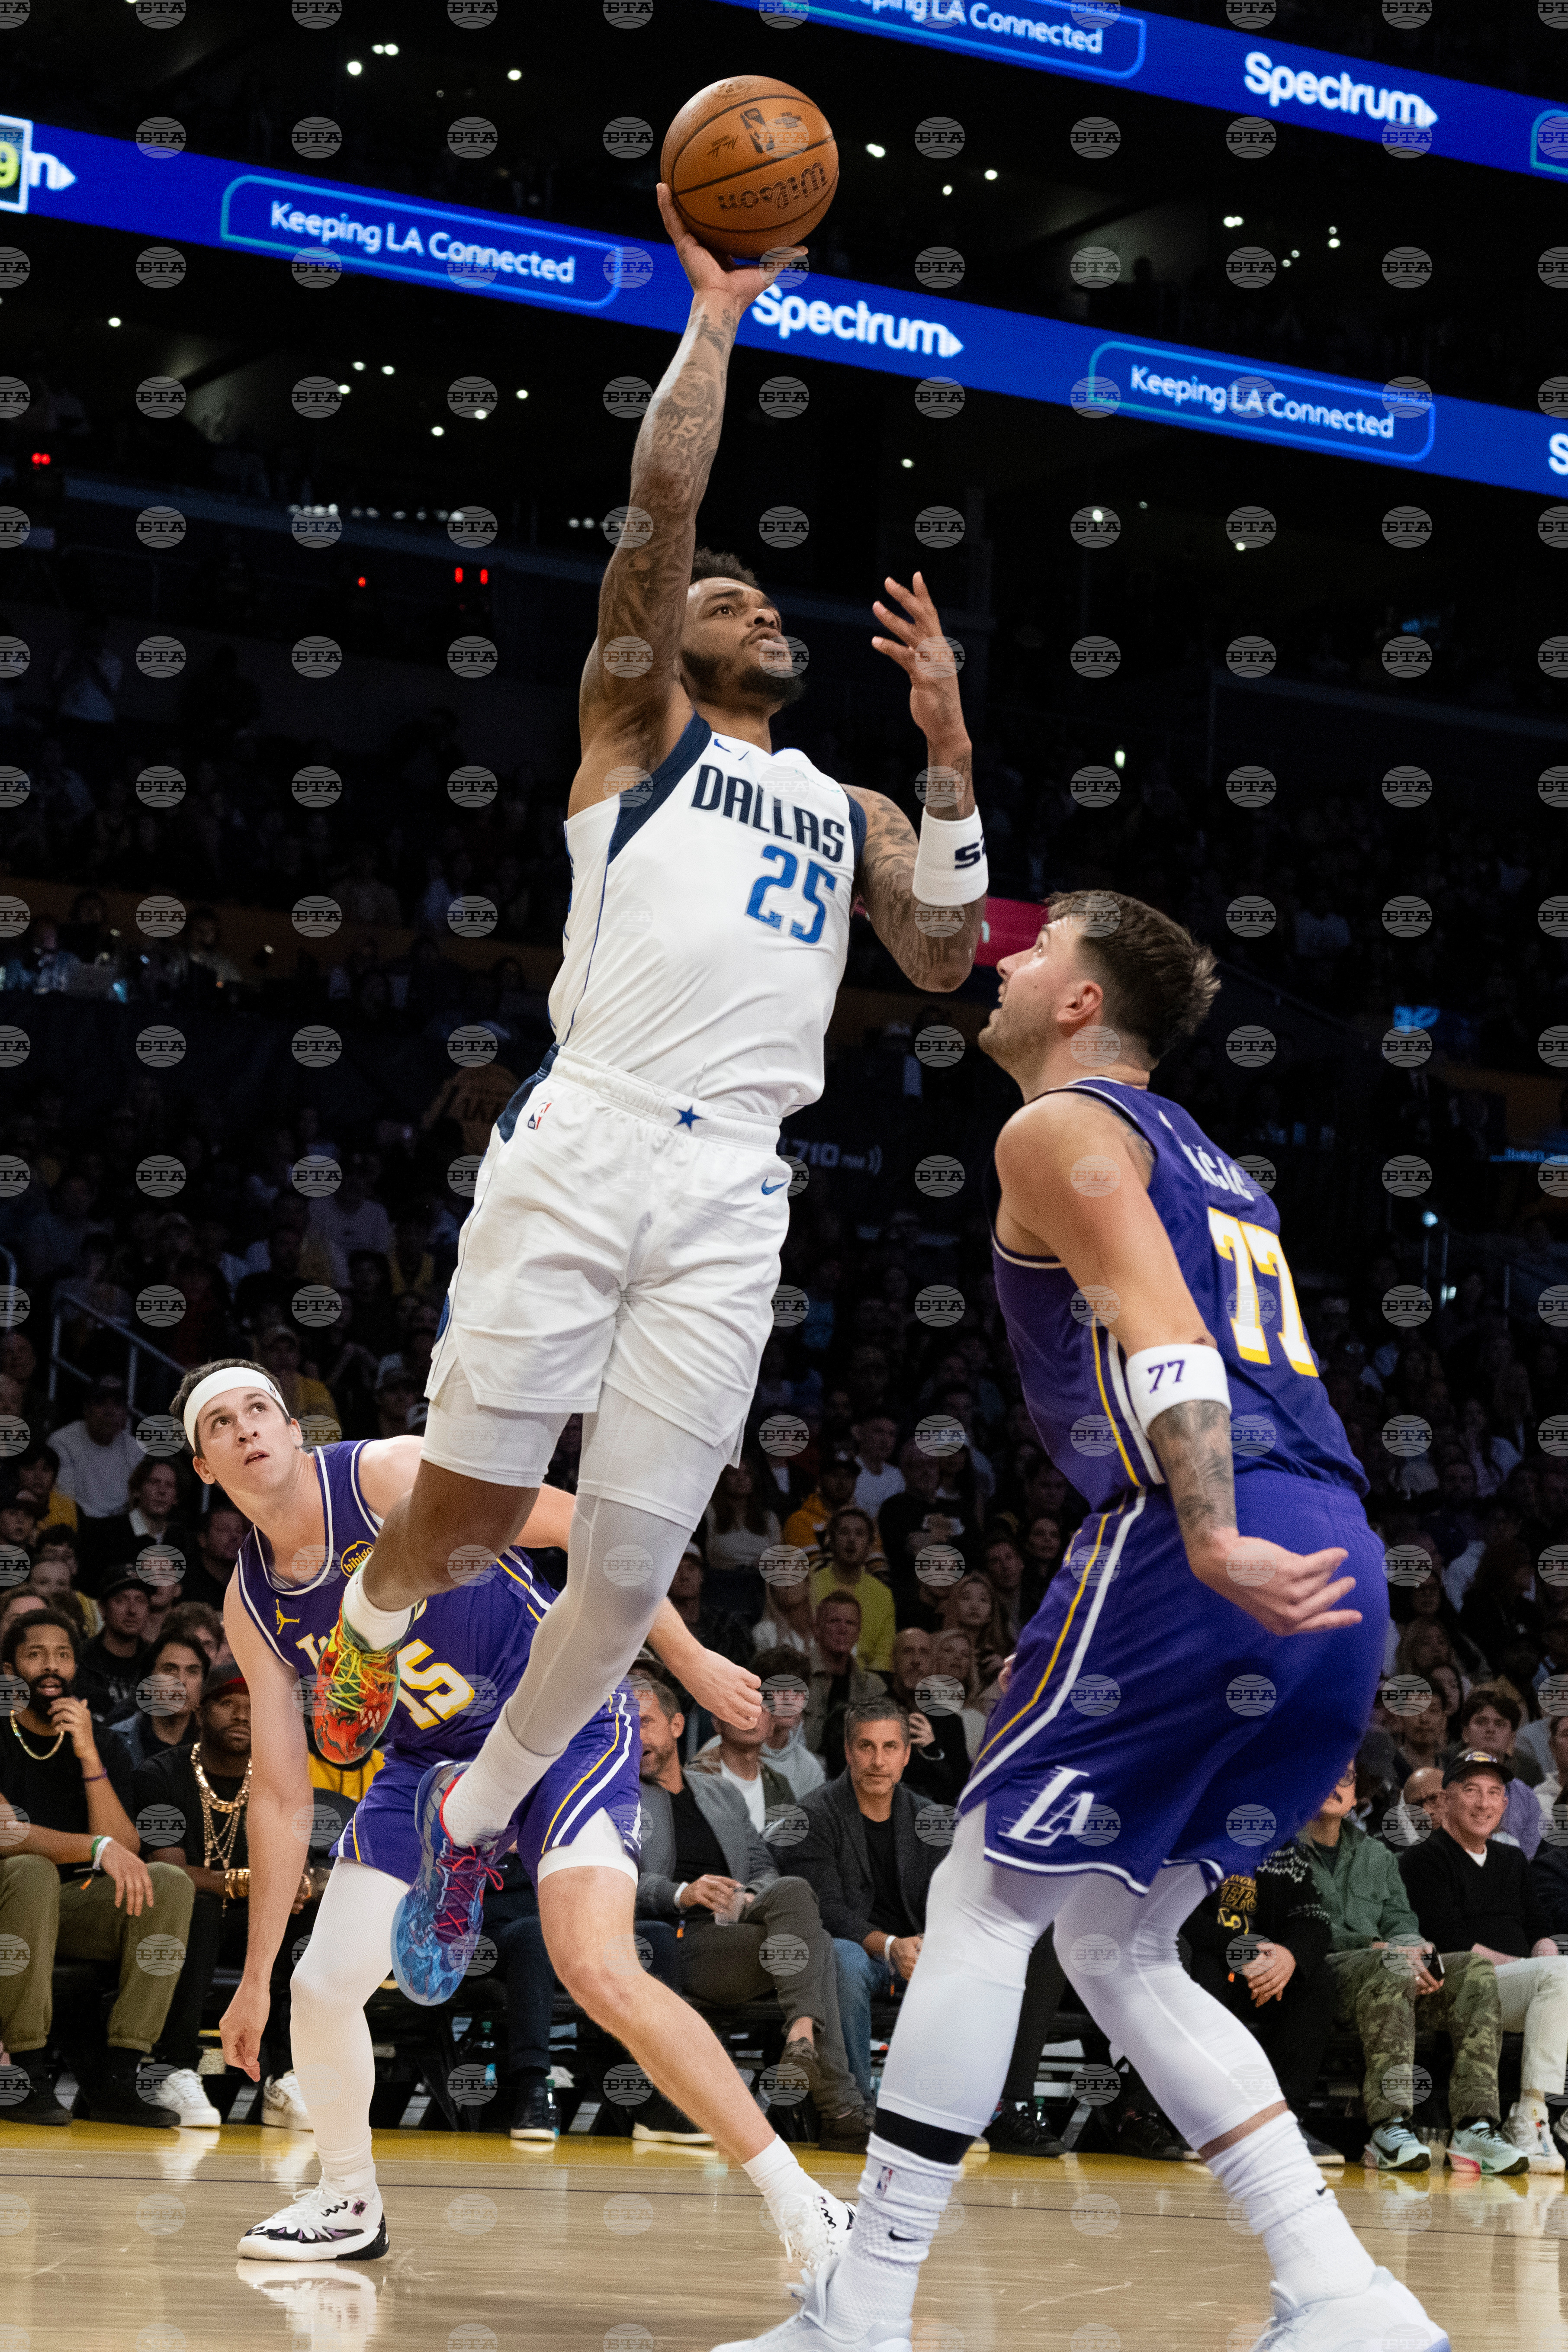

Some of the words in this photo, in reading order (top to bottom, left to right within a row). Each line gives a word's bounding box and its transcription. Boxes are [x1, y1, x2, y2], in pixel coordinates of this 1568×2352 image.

[970, 2, 1102, 55] Connected
[1244, 51, 1431, 128] Spectrum
[718, 161, 828, 209] Wilson
[271, 200, 382, 254] Keeping
[387, 223, 424, 256] LA
[429, 232, 575, 283] Connected
[752, 283, 957, 358] Spectrum
[1131, 364, 1227, 413] Keeping
[1230, 383, 1264, 413] LA
[1268, 392, 1394, 439] Connected
[690, 763, 845, 863] DALLAS
[954, 842, 986, 870] S
[745, 844, 837, 945] 25
[1208, 1206, 1319, 1378] 77
[1147, 1359, 1185, 1394] 77
[343, 1546, 374, 1573] bibigo
[998, 1765, 1094, 1847] LA
